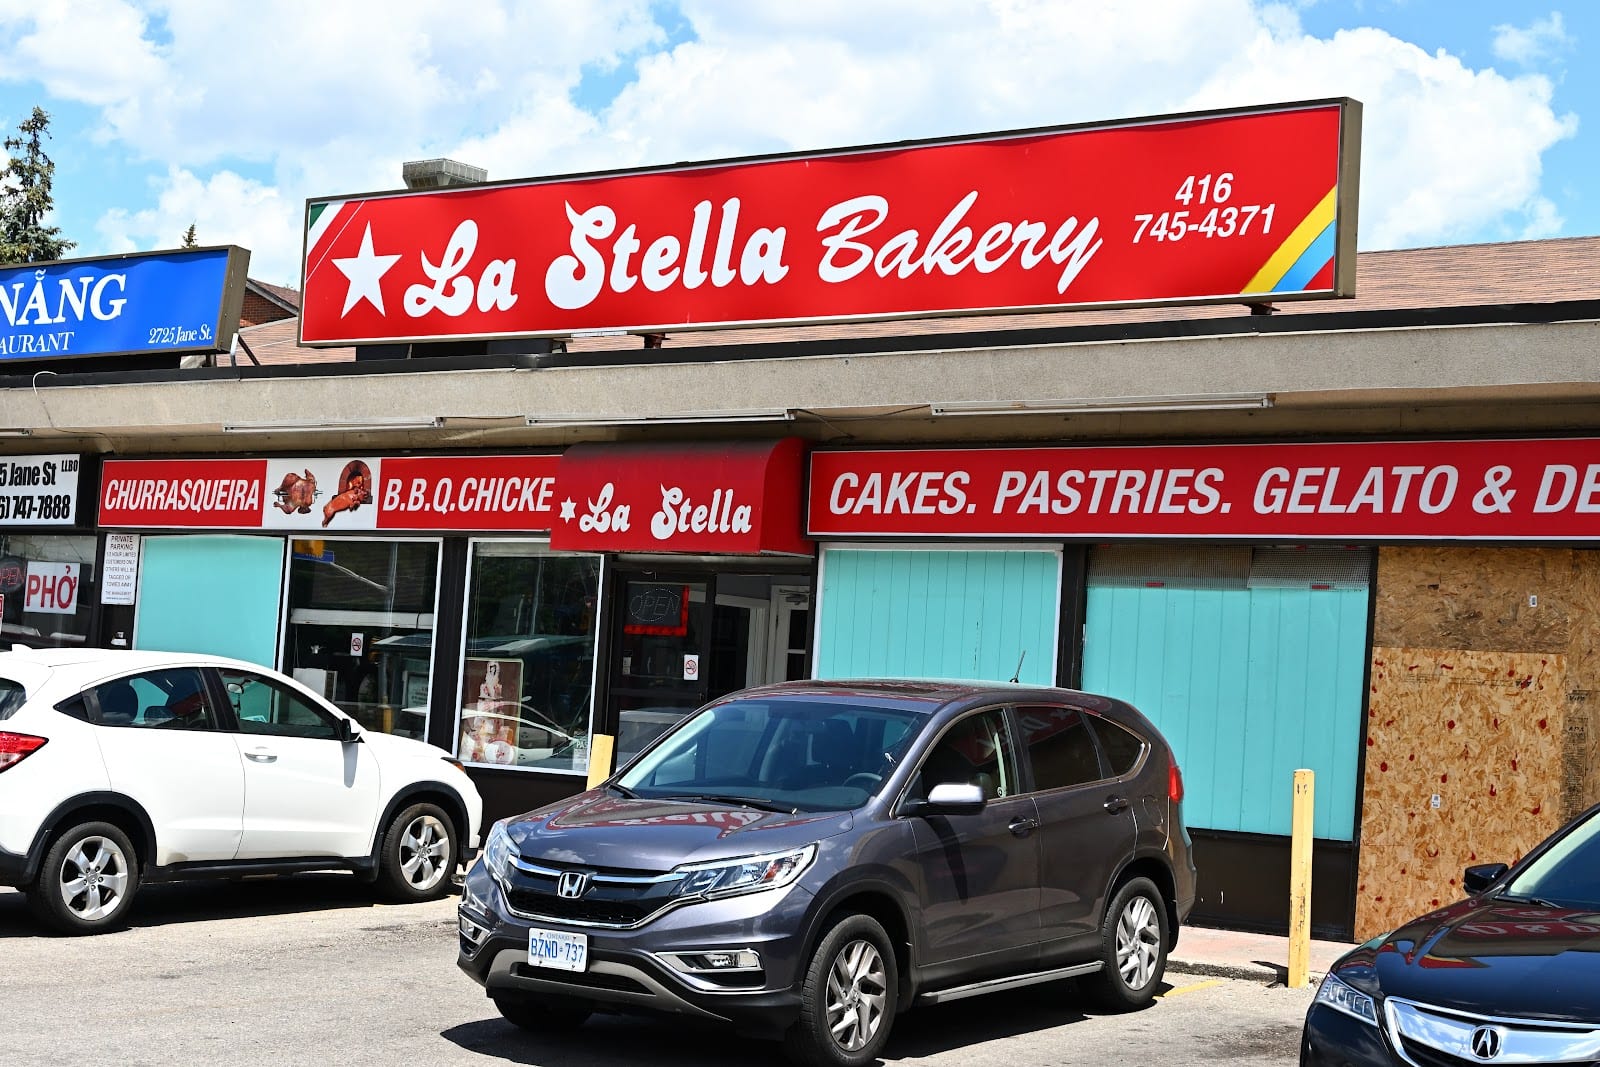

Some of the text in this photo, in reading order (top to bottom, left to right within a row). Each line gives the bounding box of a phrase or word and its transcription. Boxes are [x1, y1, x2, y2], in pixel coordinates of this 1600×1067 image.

[1175, 172, 1234, 206] 416
[1132, 204, 1276, 244] 745-4371
[403, 190, 1103, 318] La Stella Bakery
[148, 323, 212, 345] 2725 Jane St.
[8, 462, 41, 487] Jane
[42, 461, 57, 486] St
[61, 459, 79, 472] LLBO
[12, 494, 71, 519] 747-7888
[104, 478, 260, 513] CHURRASQUEIRA
[829, 471, 977, 515] CAKES.
[992, 468, 1233, 515] PASTRIES.
[1252, 464, 1459, 515] GELATO
[1471, 464, 1517, 515] &
[579, 482, 752, 540] La Stella
[26, 565, 77, 609] PHỞ
[629, 595, 680, 618] OPEN
[530, 937, 584, 963] BZND 737
